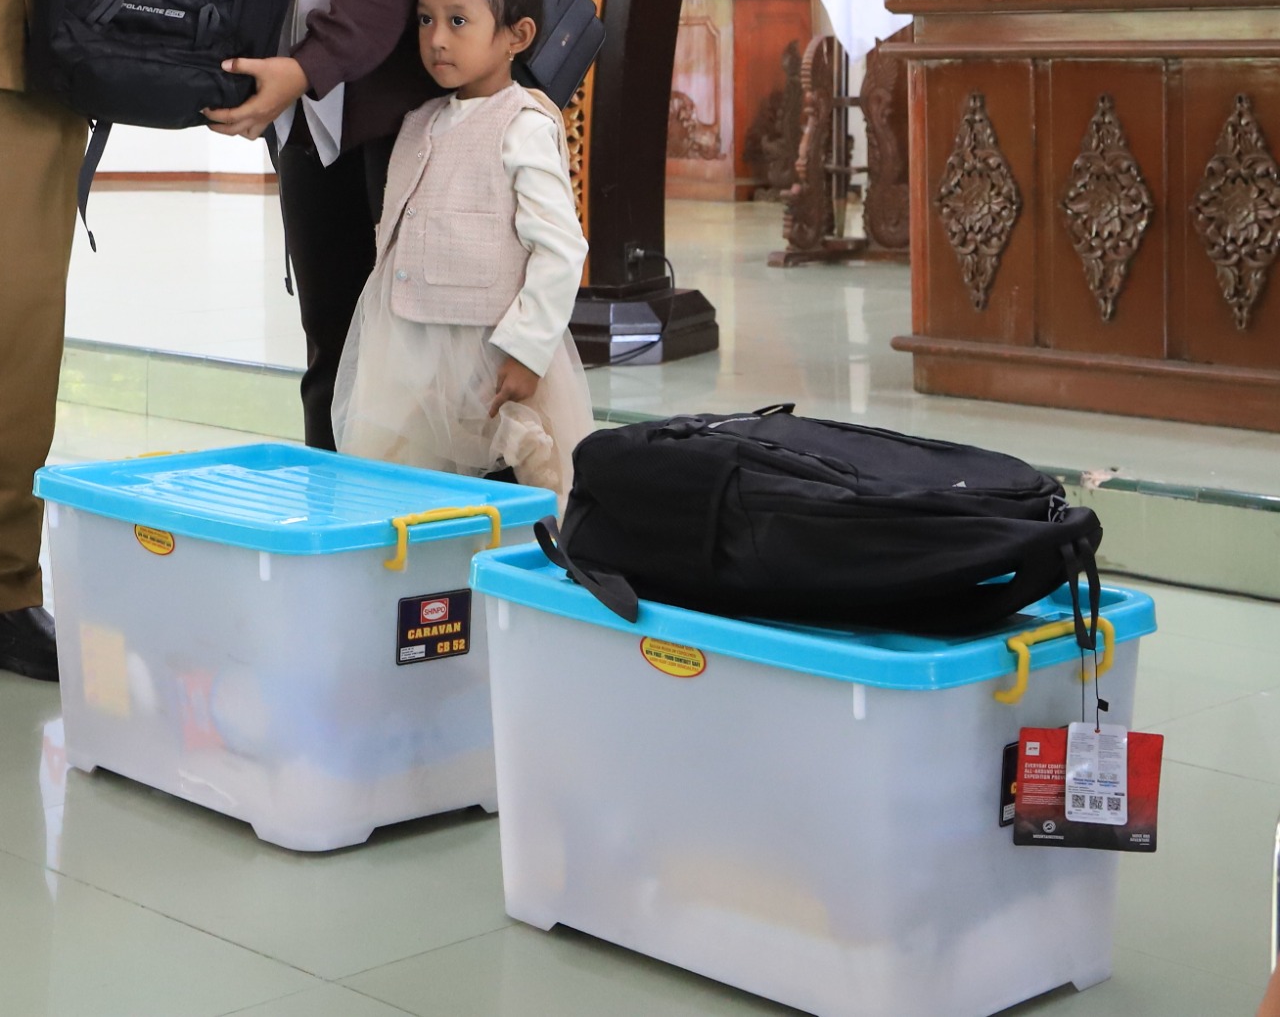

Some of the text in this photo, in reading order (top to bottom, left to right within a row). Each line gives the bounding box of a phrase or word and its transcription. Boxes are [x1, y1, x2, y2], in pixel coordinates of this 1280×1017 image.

[424, 605, 446, 616] SHINPO
[407, 622, 462, 640] CARAVAN
[437, 639, 466, 653] CB 52
